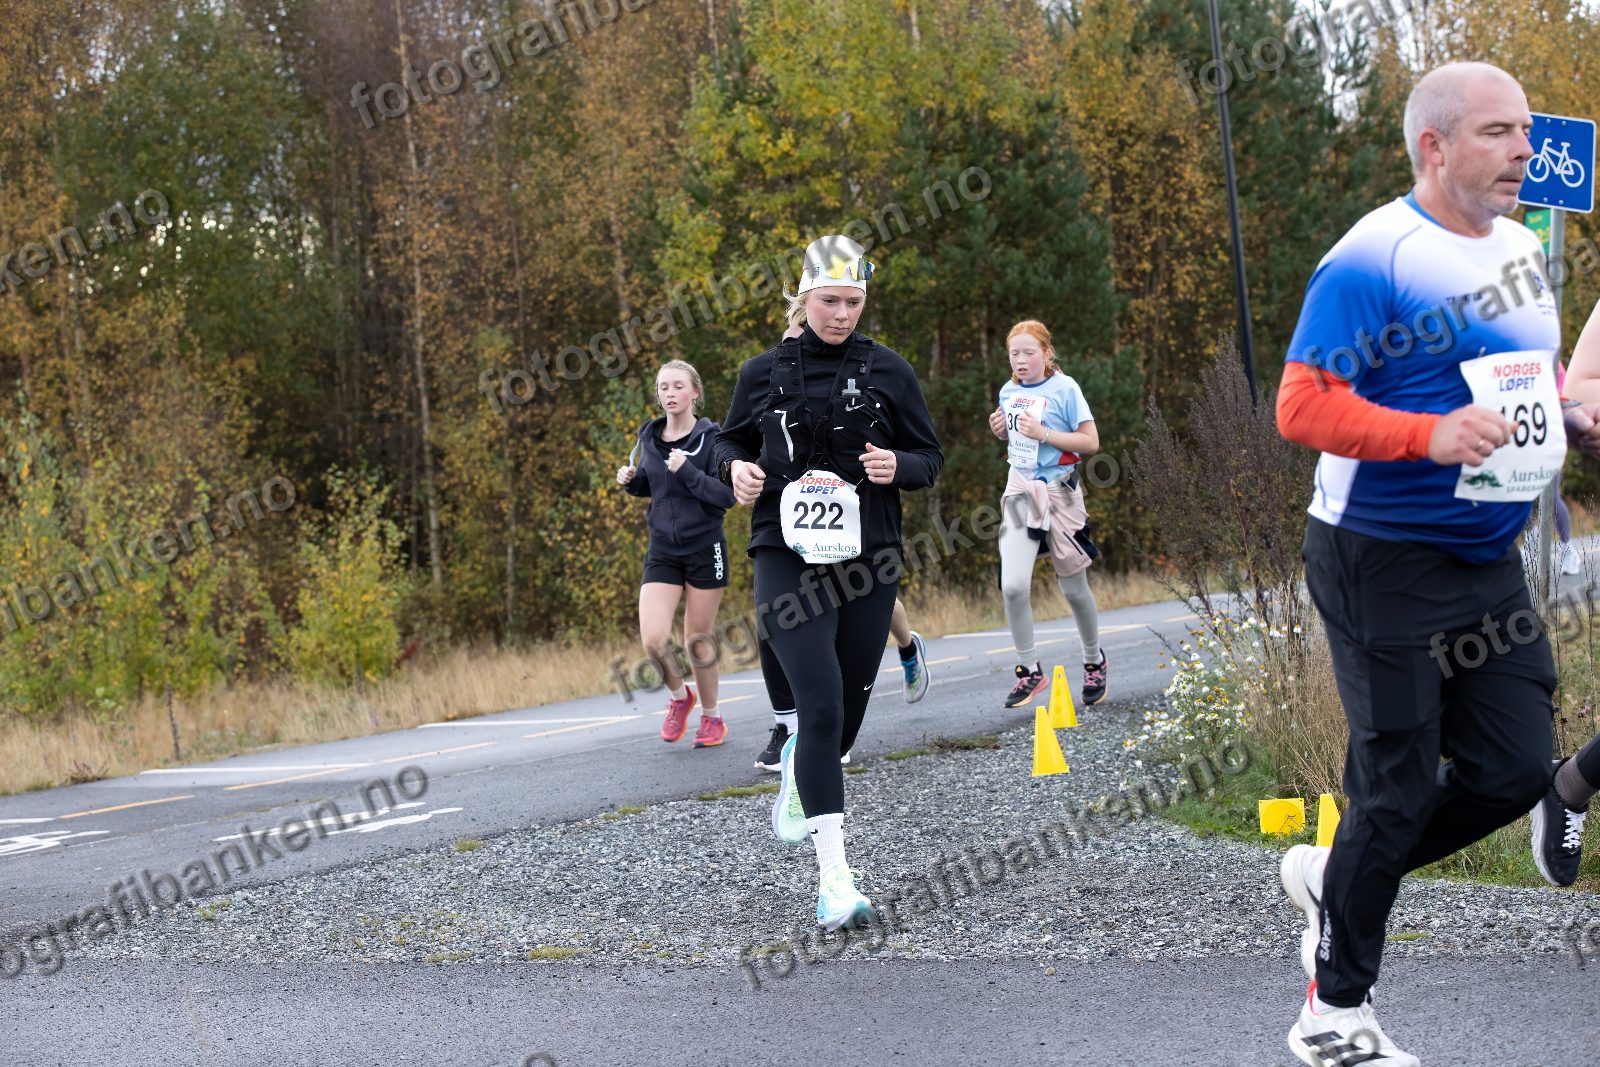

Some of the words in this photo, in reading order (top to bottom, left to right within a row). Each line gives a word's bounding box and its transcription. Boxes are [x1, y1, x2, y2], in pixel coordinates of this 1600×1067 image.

[1493, 362, 1541, 378] NORGES
[1499, 376, 1536, 392] LØPET
[1501, 402, 1548, 448] 69
[799, 477, 846, 488] NORGES
[800, 485, 838, 495] LØPET
[794, 501, 844, 530] 222
[812, 542, 858, 556] Aurskog
[713, 541, 724, 581] adidas
